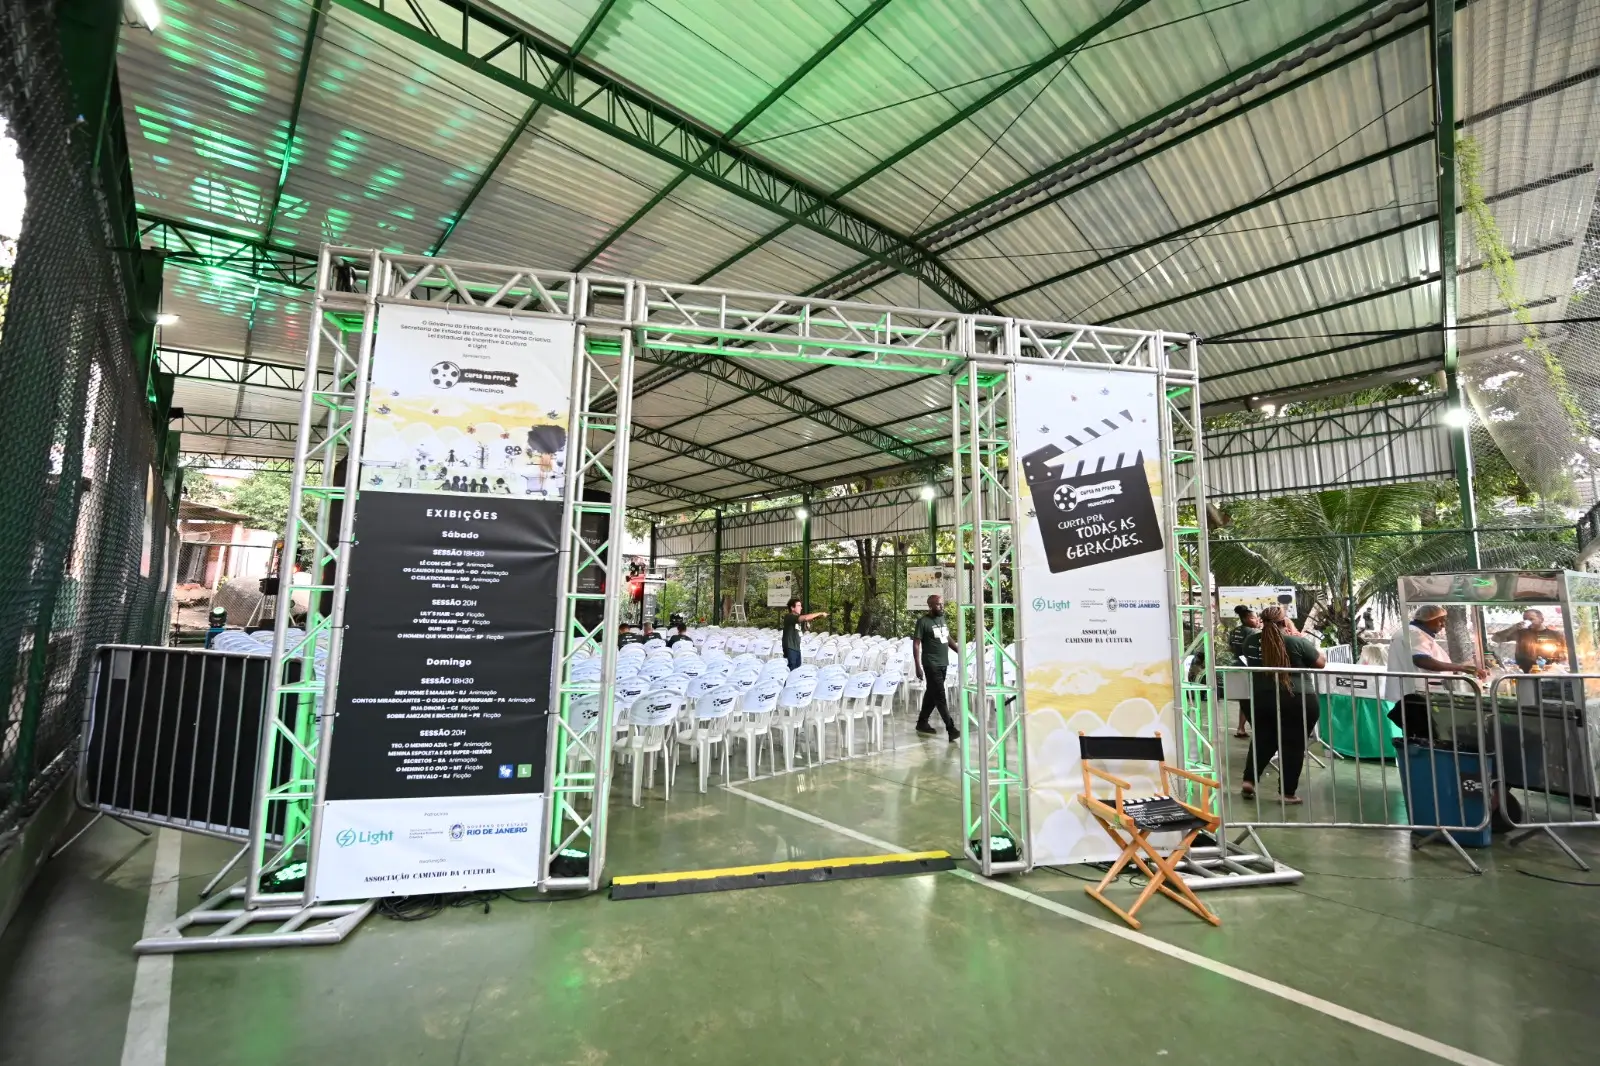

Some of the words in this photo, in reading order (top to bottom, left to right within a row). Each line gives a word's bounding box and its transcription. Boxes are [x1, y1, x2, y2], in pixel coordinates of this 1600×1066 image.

[426, 509, 498, 521] EXIBIÇÕES
[1058, 517, 1086, 529] CURTA
[1087, 513, 1104, 524] PRA
[1076, 520, 1117, 539] TODAS
[1120, 517, 1135, 530] AS
[442, 530, 479, 539] Sábado
[432, 548, 462, 556] SESSÃO
[432, 598, 462, 606] SESSÃO
[462, 599, 477, 607] 20H
[1047, 600, 1070, 611] Light
[1082, 628, 1117, 636] ASSOCIAÇÃO
[426, 658, 472, 667] Domingo
[421, 676, 451, 684] SESSÃO
[419, 728, 450, 737] SESSÃO
[495, 827, 528, 835] JANEIRO
[359, 830, 394, 845] Light
[364, 873, 410, 882] ASSOCIAÇÃO
